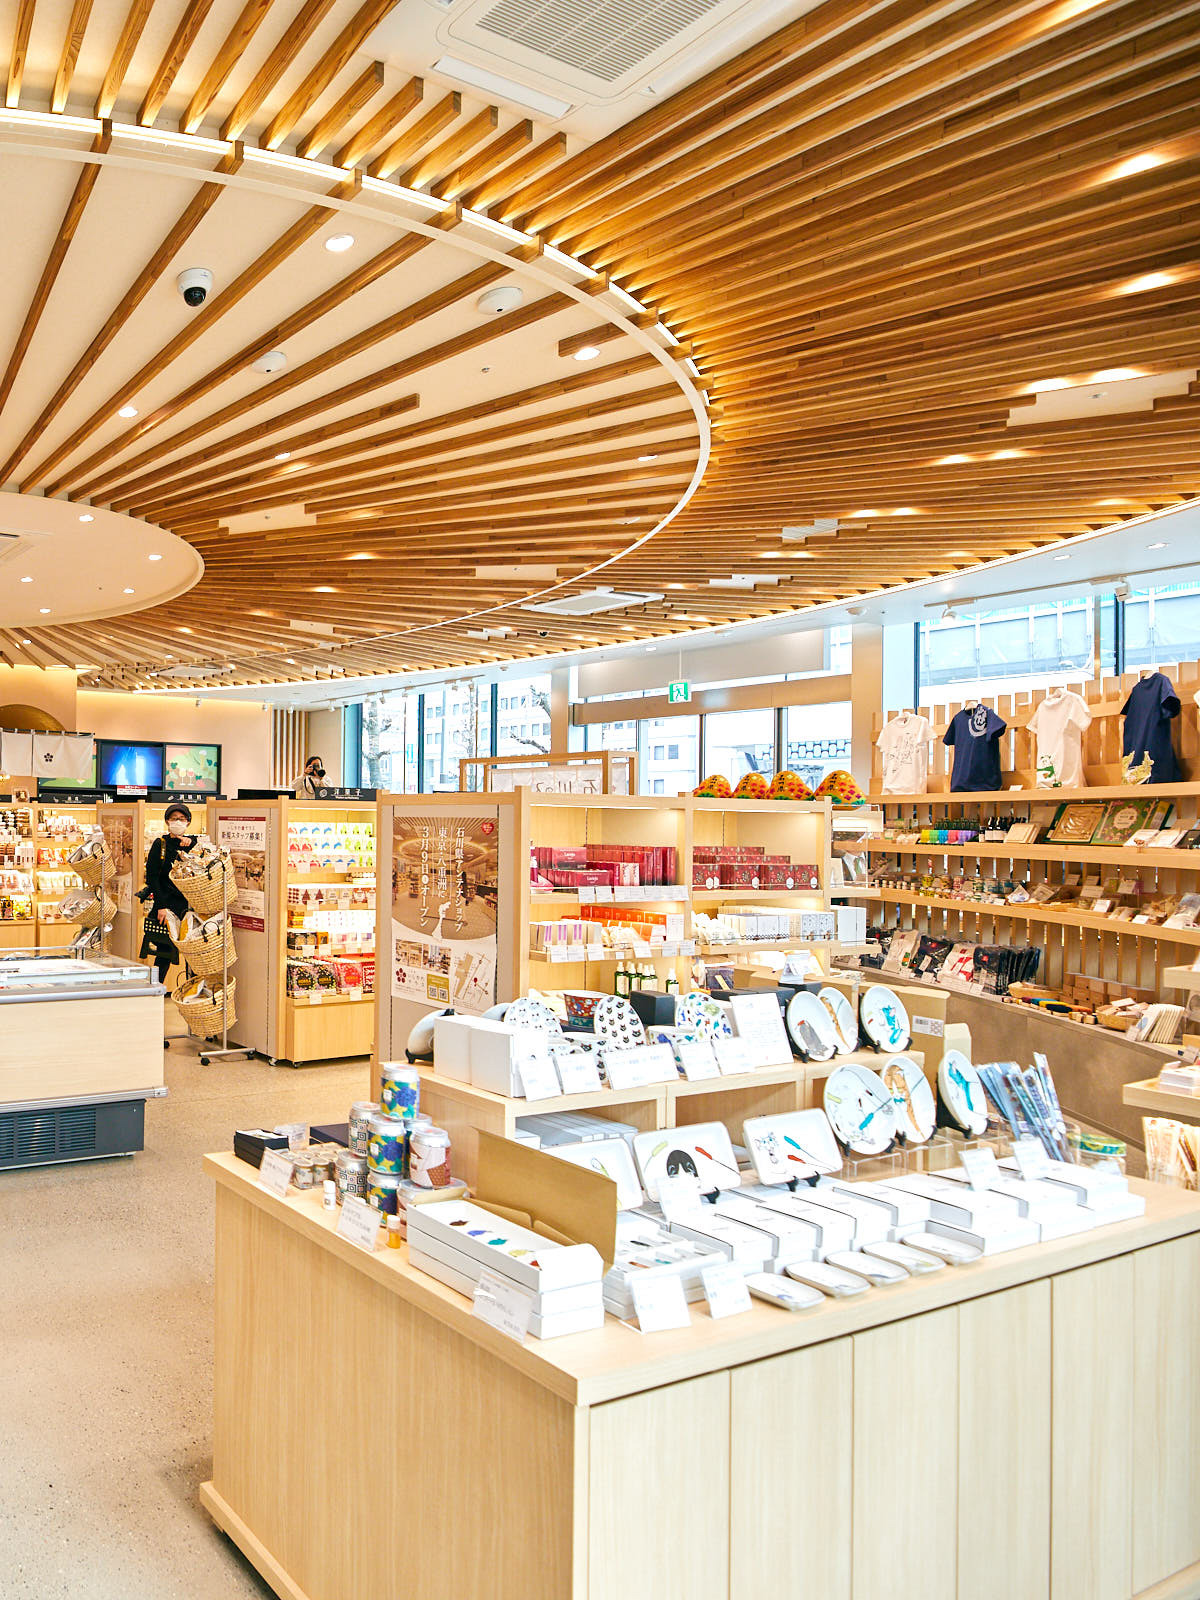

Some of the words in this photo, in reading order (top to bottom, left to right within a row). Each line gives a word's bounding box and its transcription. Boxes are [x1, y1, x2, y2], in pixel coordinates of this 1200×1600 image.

[455, 827, 465, 933] 石川県アンテナショップ
